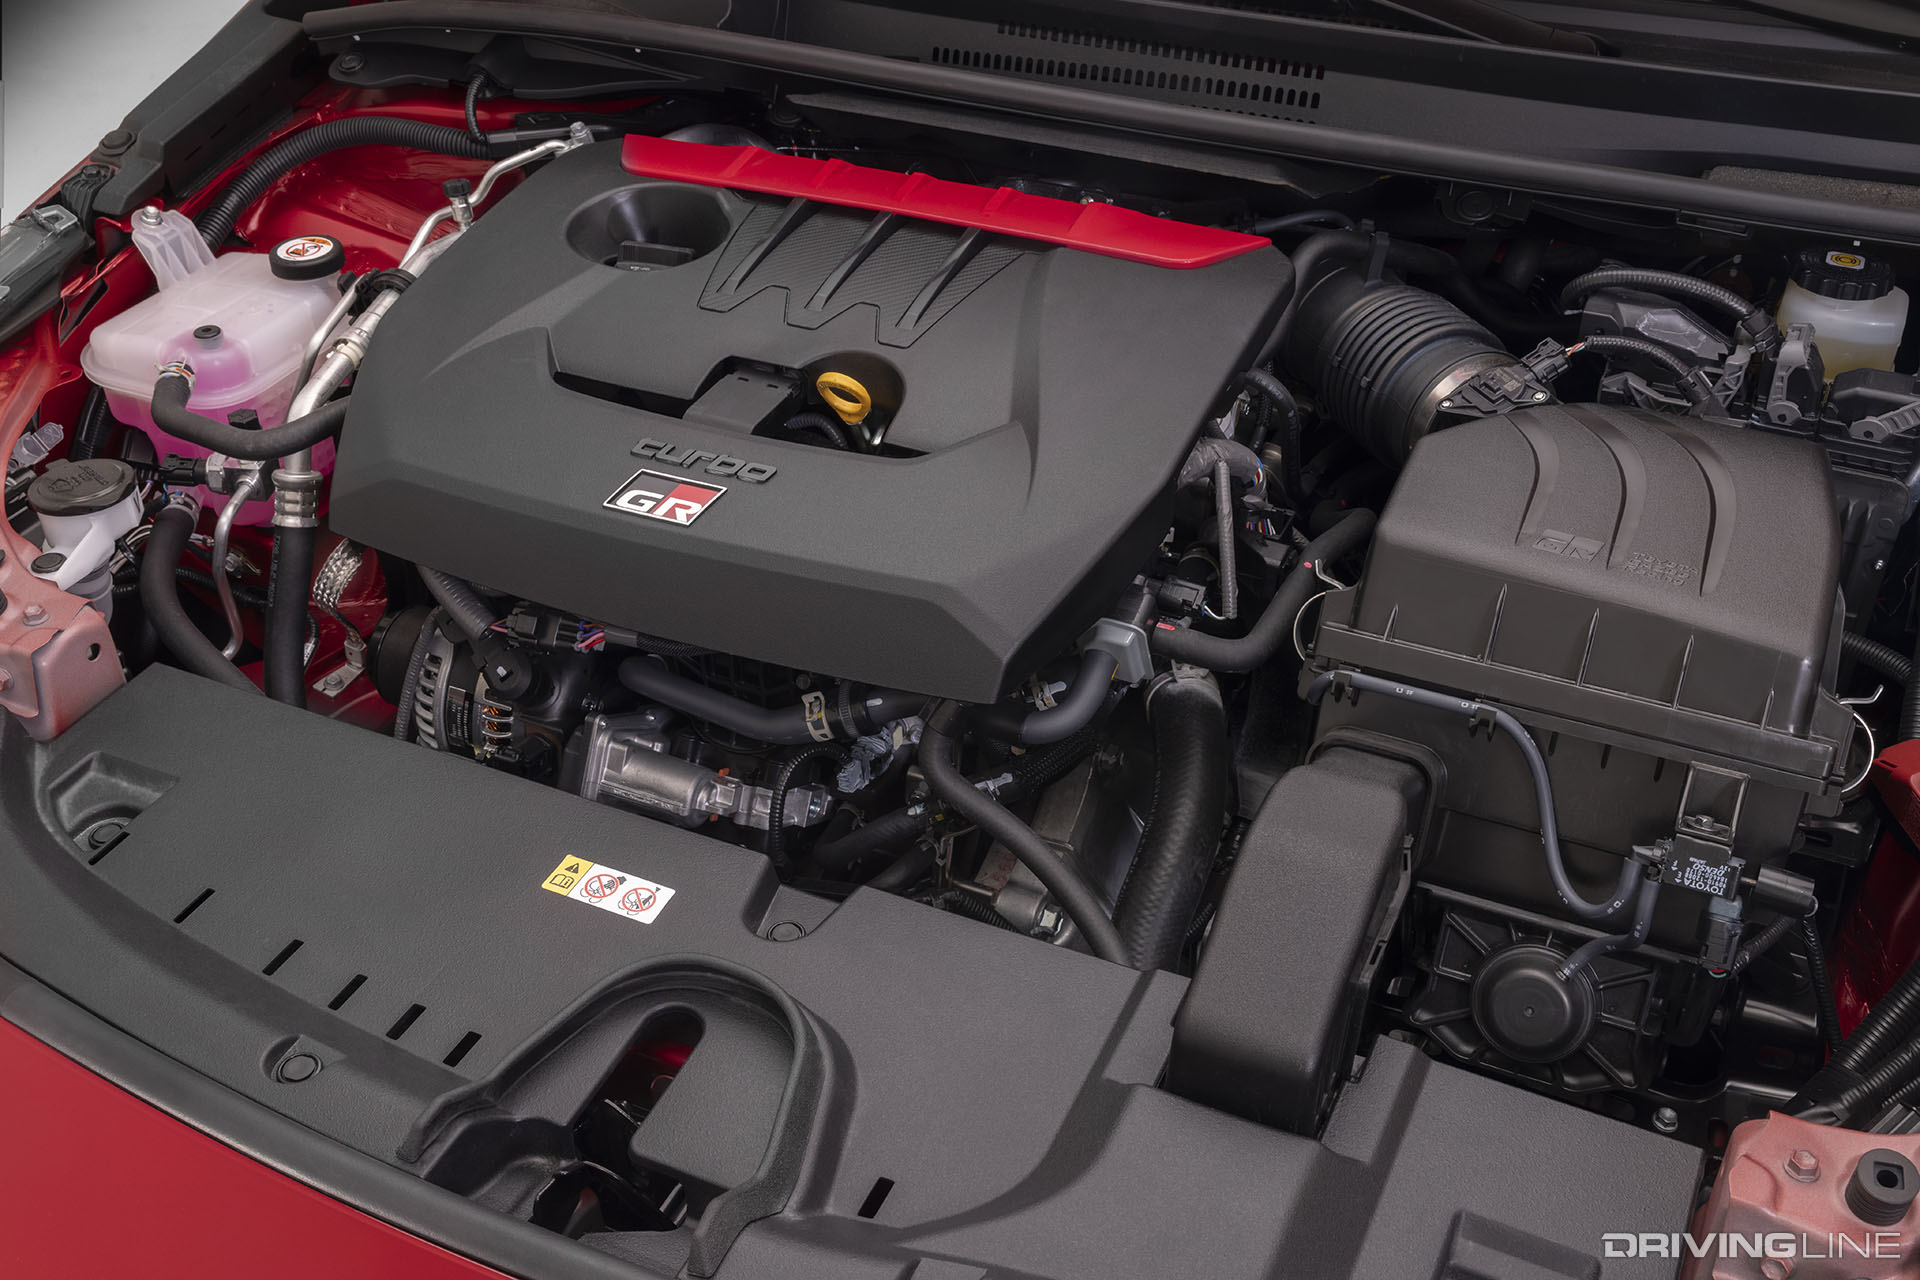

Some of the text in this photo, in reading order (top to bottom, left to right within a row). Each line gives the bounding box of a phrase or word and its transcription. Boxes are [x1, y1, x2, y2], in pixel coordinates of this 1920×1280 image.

[614, 489, 704, 523] GR
[1692, 863, 1725, 877] DENSO
[1684, 877, 1724, 896] TOYOTA
